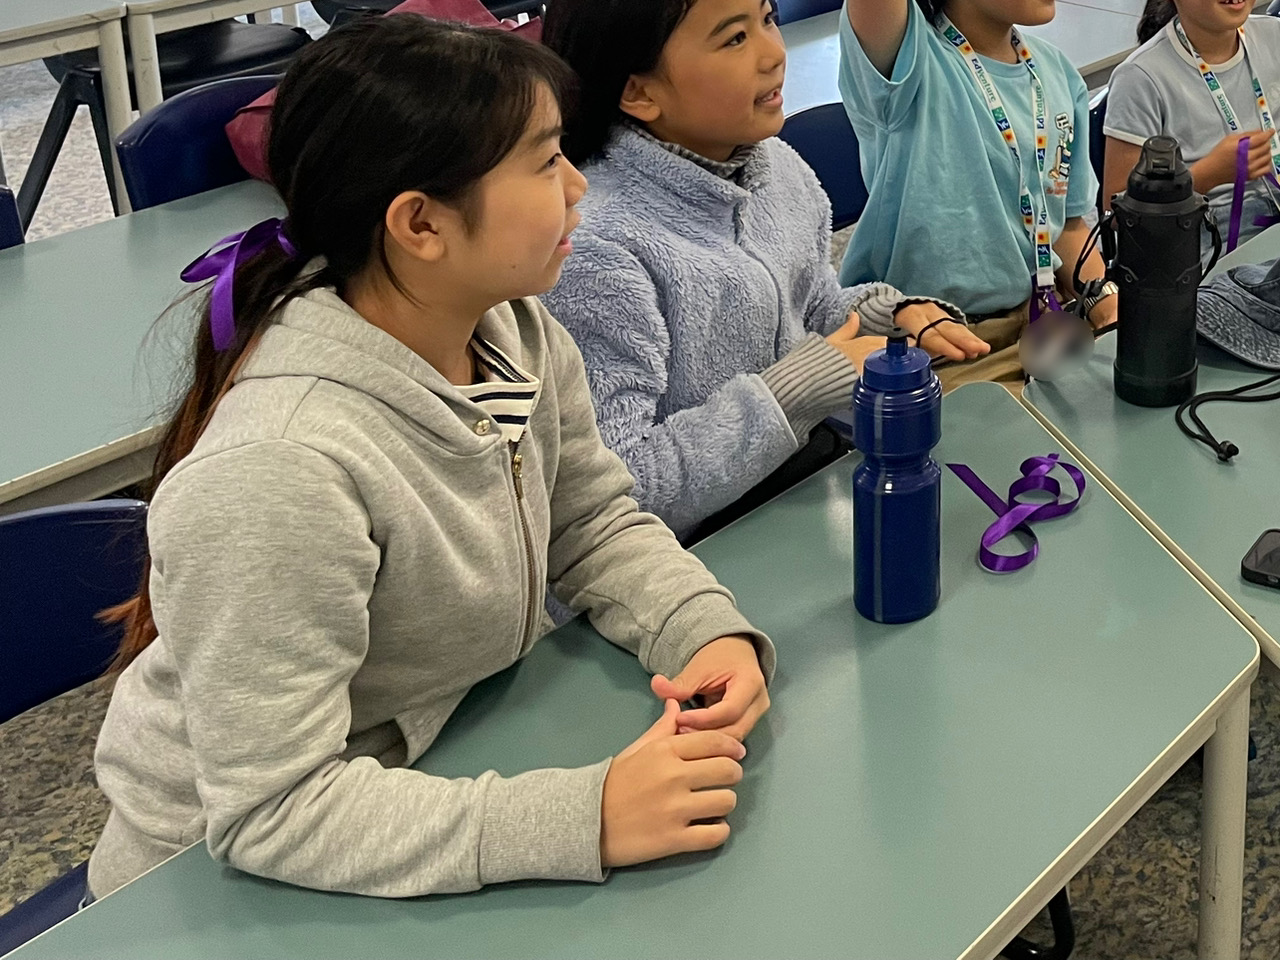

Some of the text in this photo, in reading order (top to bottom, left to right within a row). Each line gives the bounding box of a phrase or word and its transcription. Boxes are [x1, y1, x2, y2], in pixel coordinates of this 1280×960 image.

[971, 57, 997, 103] EdVenture
[1035, 85, 1045, 130] EdVenture
[1216, 93, 1238, 131] EdVenture
